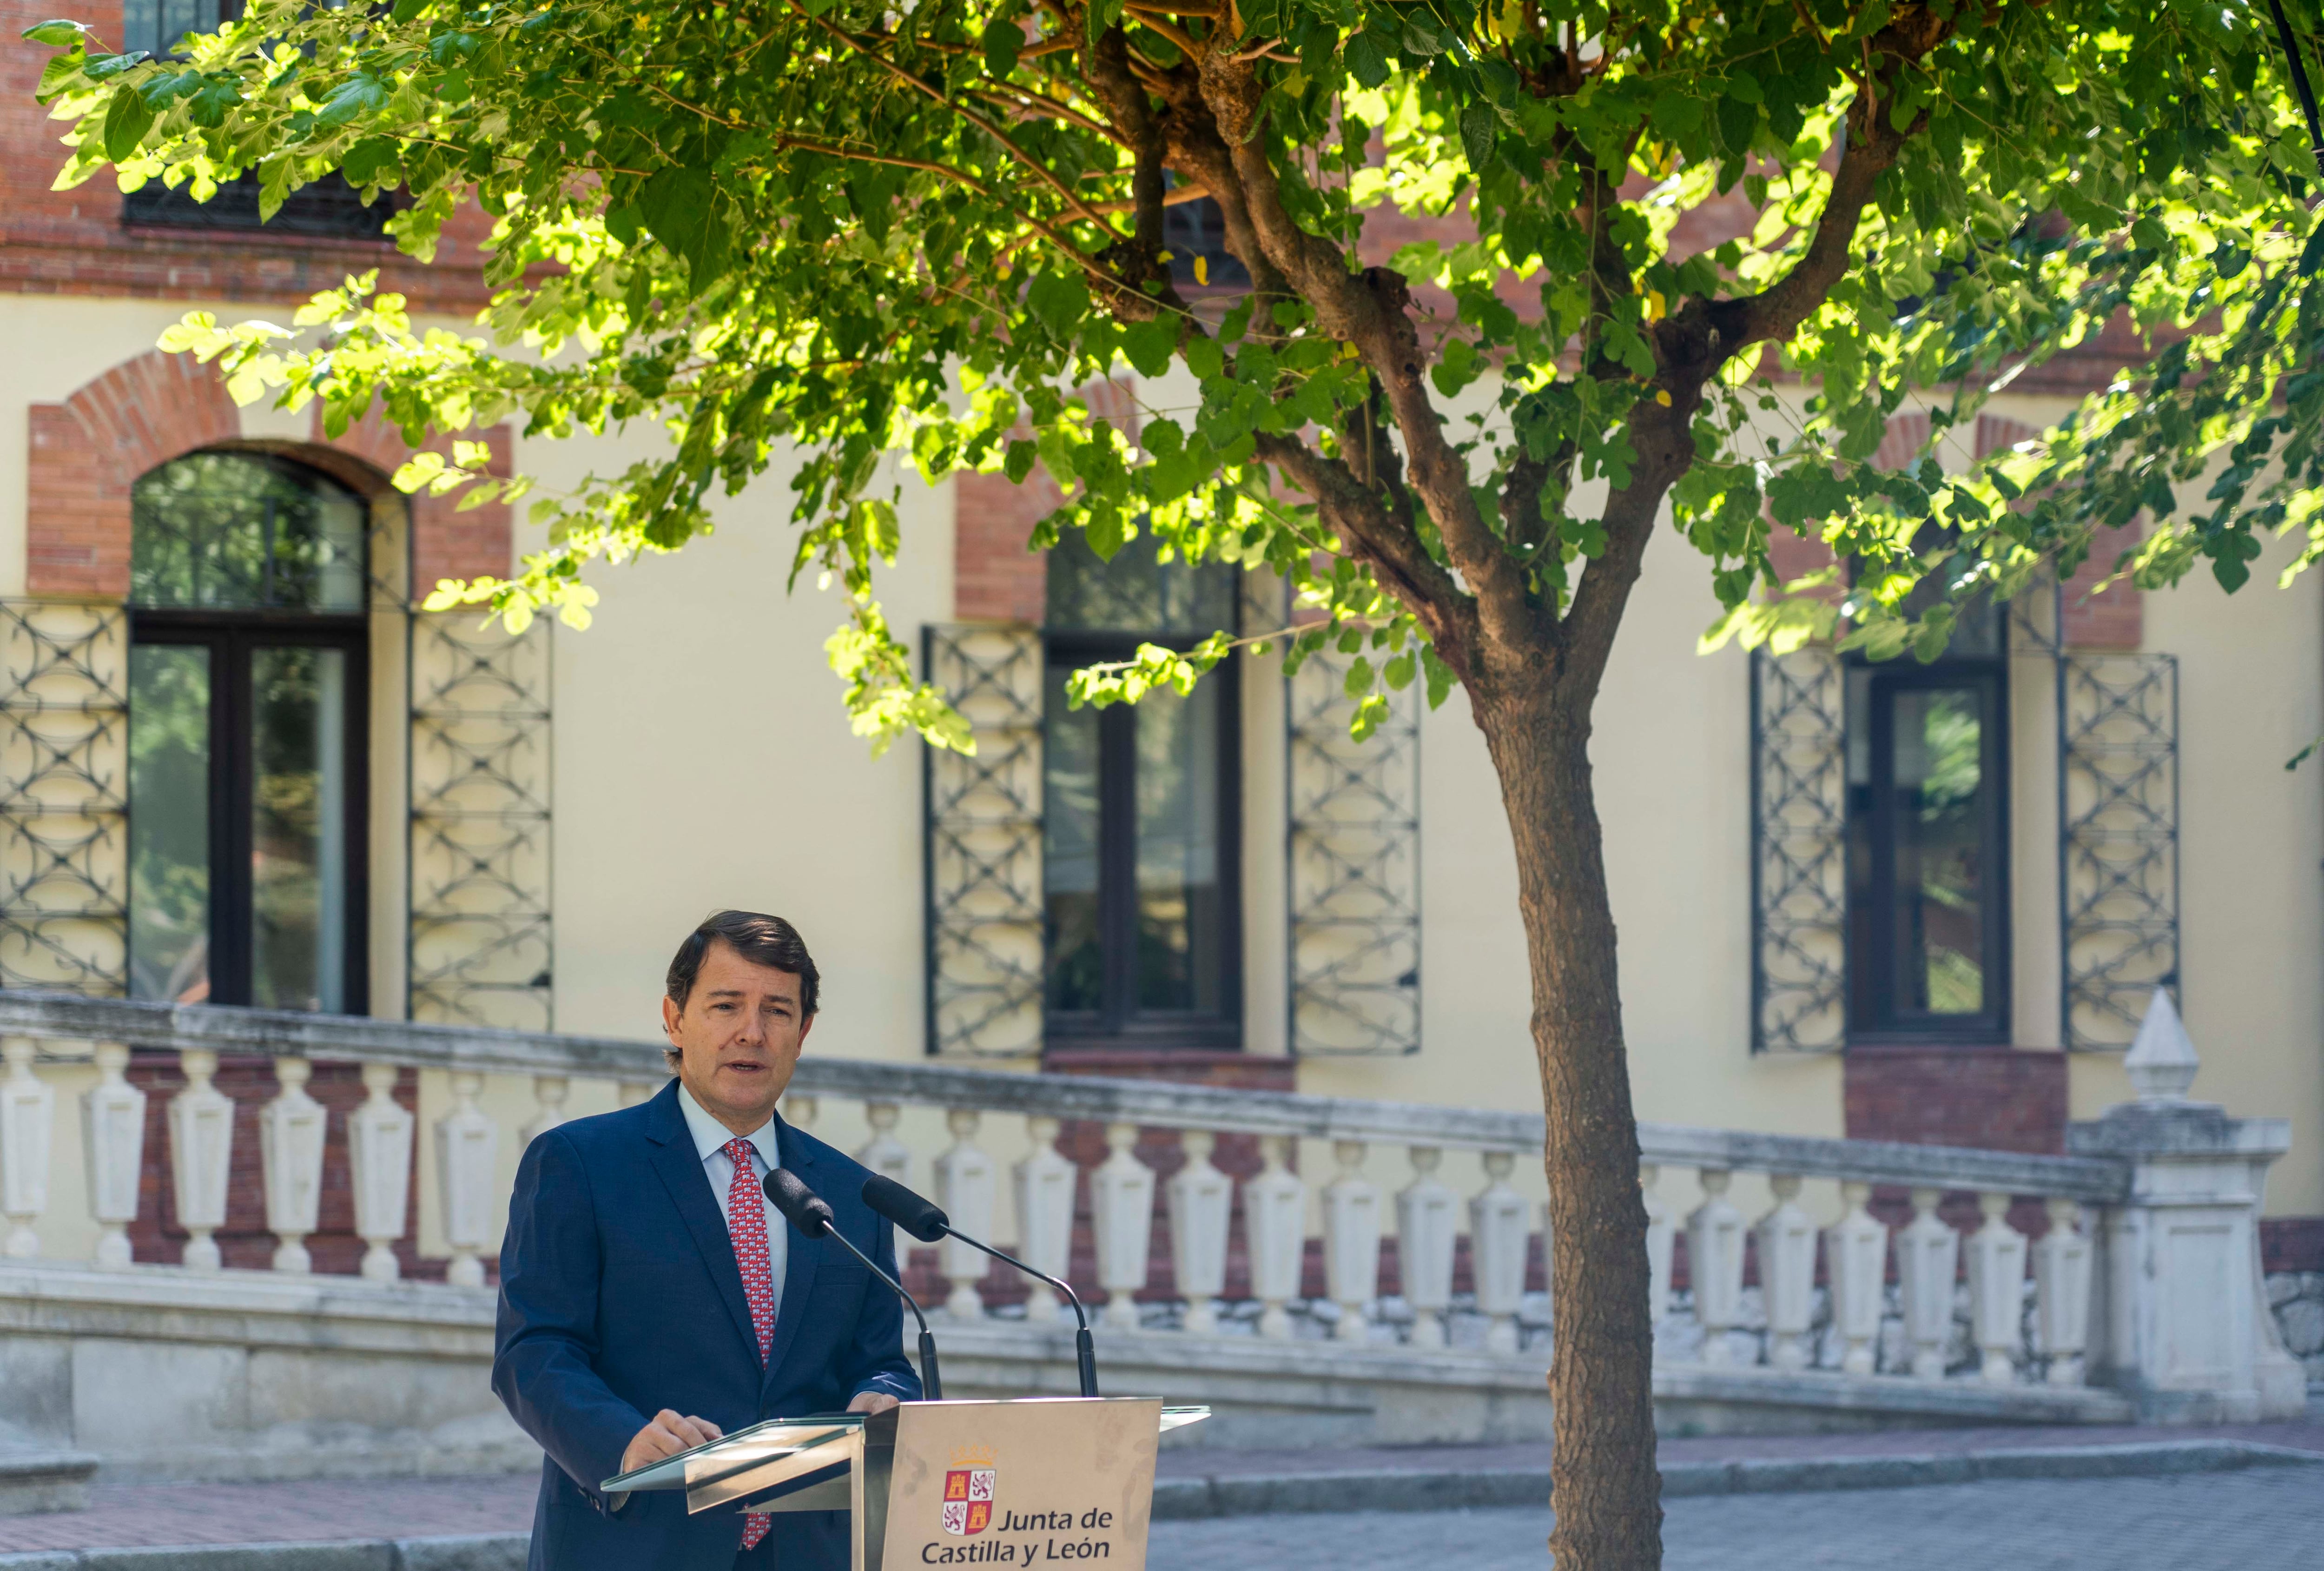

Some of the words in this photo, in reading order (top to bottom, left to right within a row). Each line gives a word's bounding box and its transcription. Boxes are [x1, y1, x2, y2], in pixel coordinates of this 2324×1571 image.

[997, 1510, 1072, 1531] Junta
[1081, 1508, 1113, 1529] de
[922, 1541, 1015, 1564] Castilla
[1021, 1544, 1038, 1568] y
[1046, 1537, 1110, 1560] León
